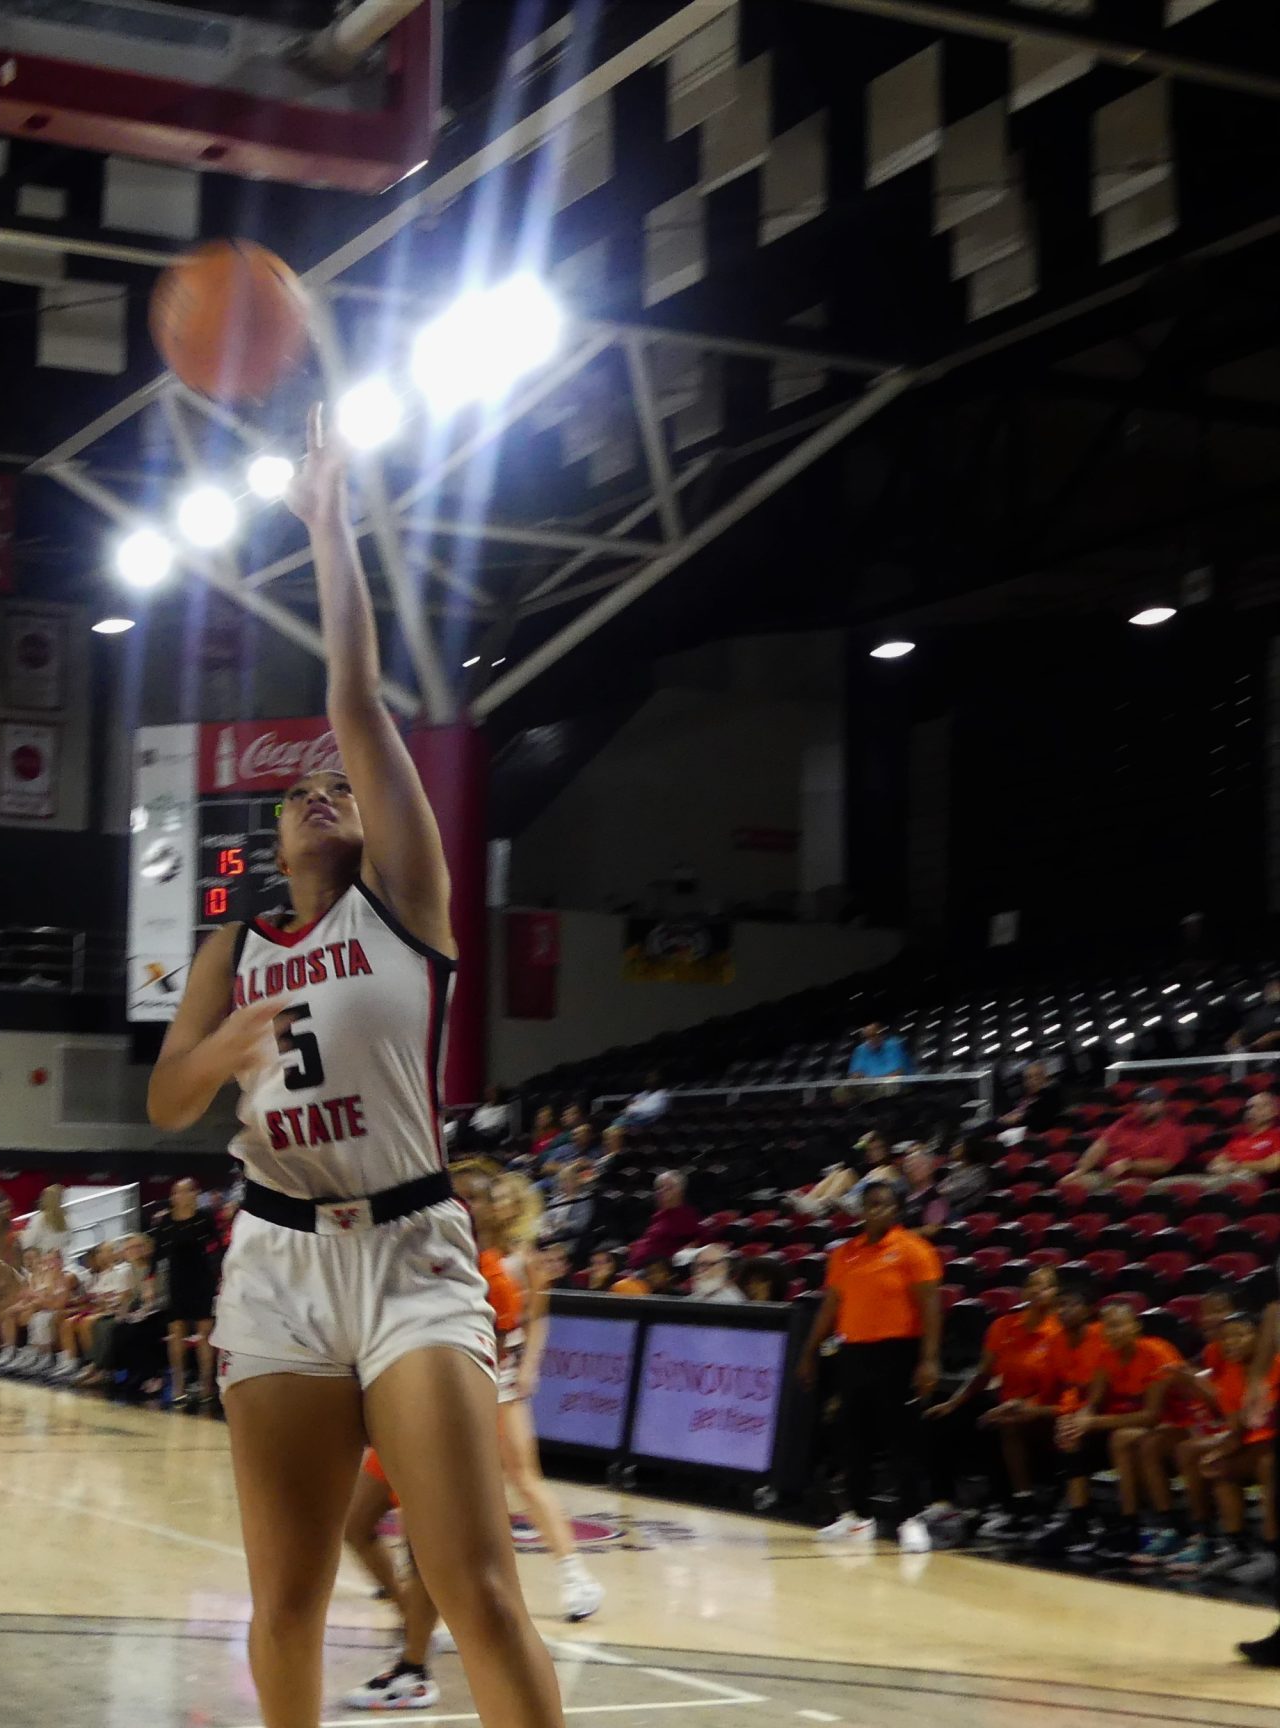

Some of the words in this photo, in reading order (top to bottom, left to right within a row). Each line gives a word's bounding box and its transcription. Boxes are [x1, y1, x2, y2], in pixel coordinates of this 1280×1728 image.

[233, 938, 374, 1008] ALDOSTA
[273, 1002, 326, 1092] 5
[265, 1095, 370, 1151] STATE
